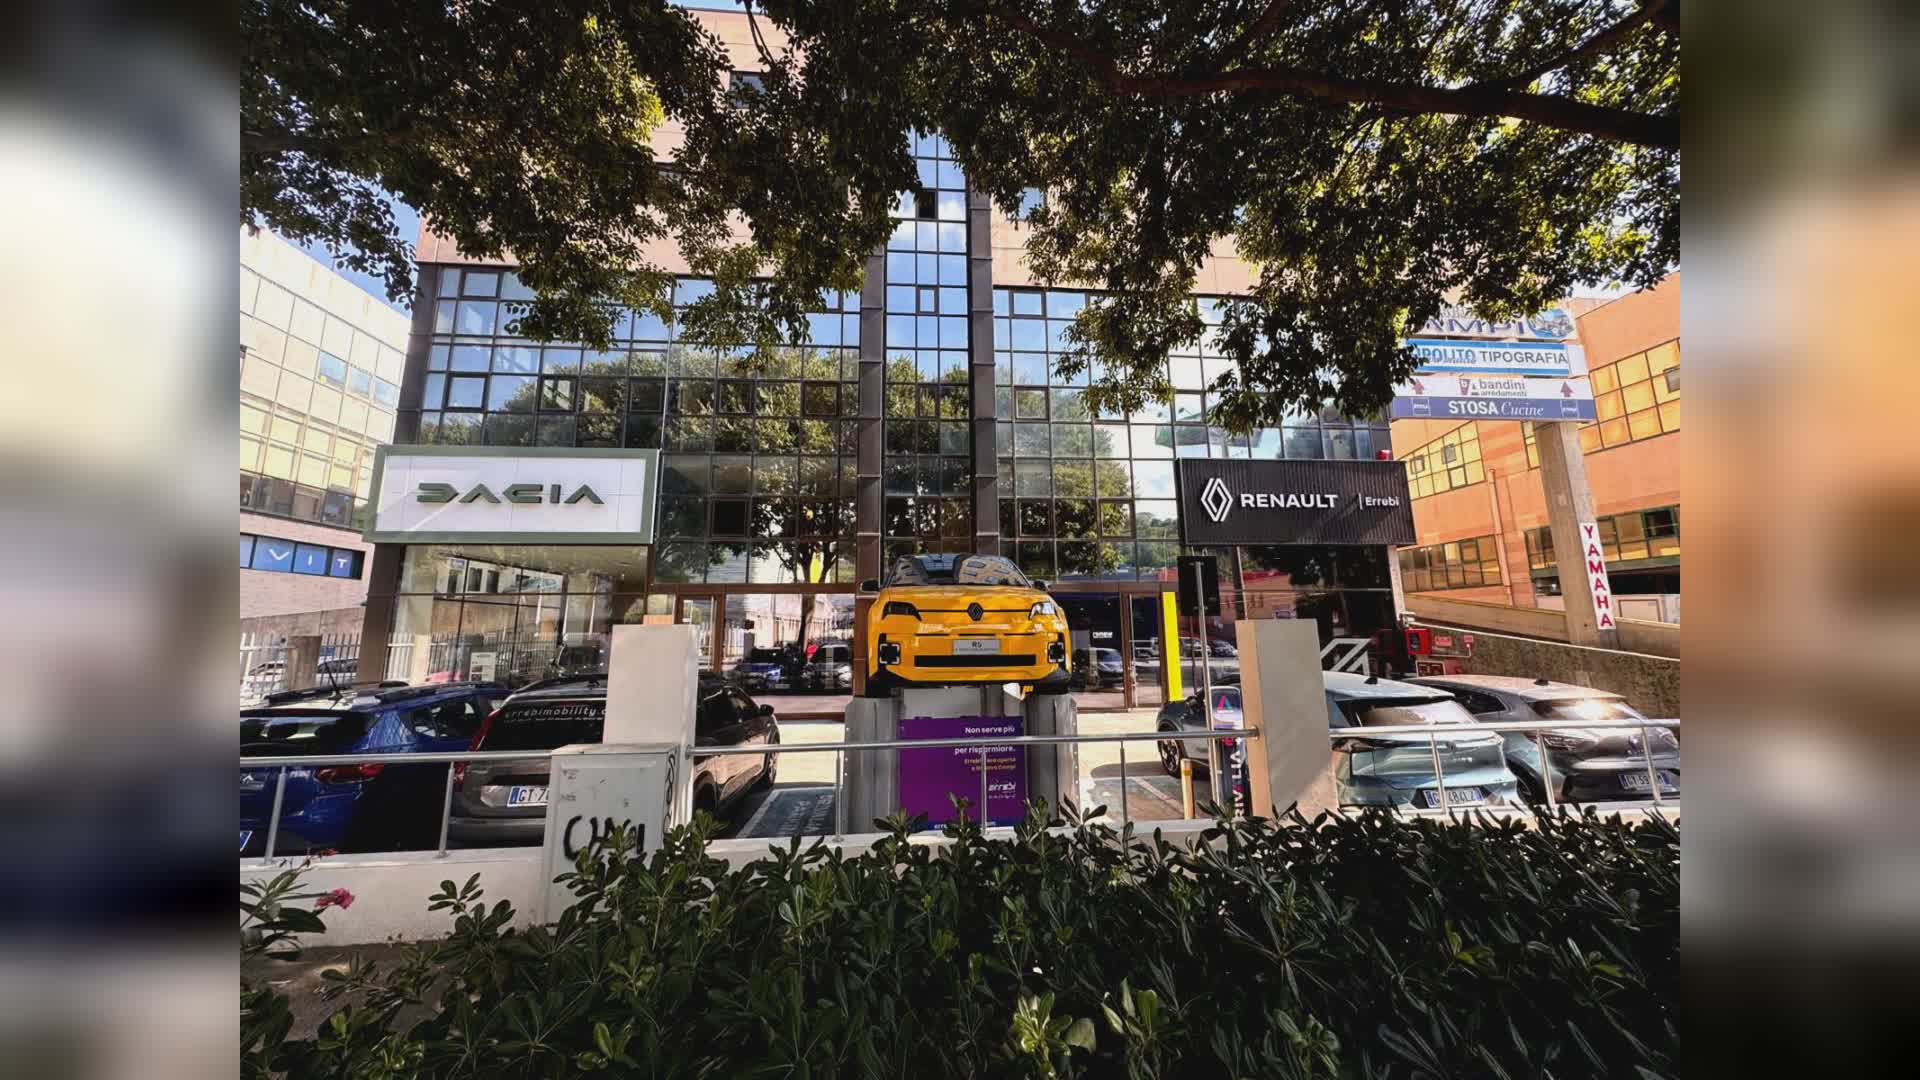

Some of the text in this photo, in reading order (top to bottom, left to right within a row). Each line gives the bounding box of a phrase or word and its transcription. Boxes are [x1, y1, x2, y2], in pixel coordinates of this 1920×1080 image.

[1480, 350, 1569, 364] TIPOGRAFIA
[1479, 379, 1526, 390] bandini
[1449, 400, 1545, 416] STOSA Cucine
[416, 482, 605, 506] DACIA
[1240, 494, 1400, 508] RENAULT Errebi
[1583, 524, 1613, 627] YAMAHA
[954, 747, 967, 755] per
